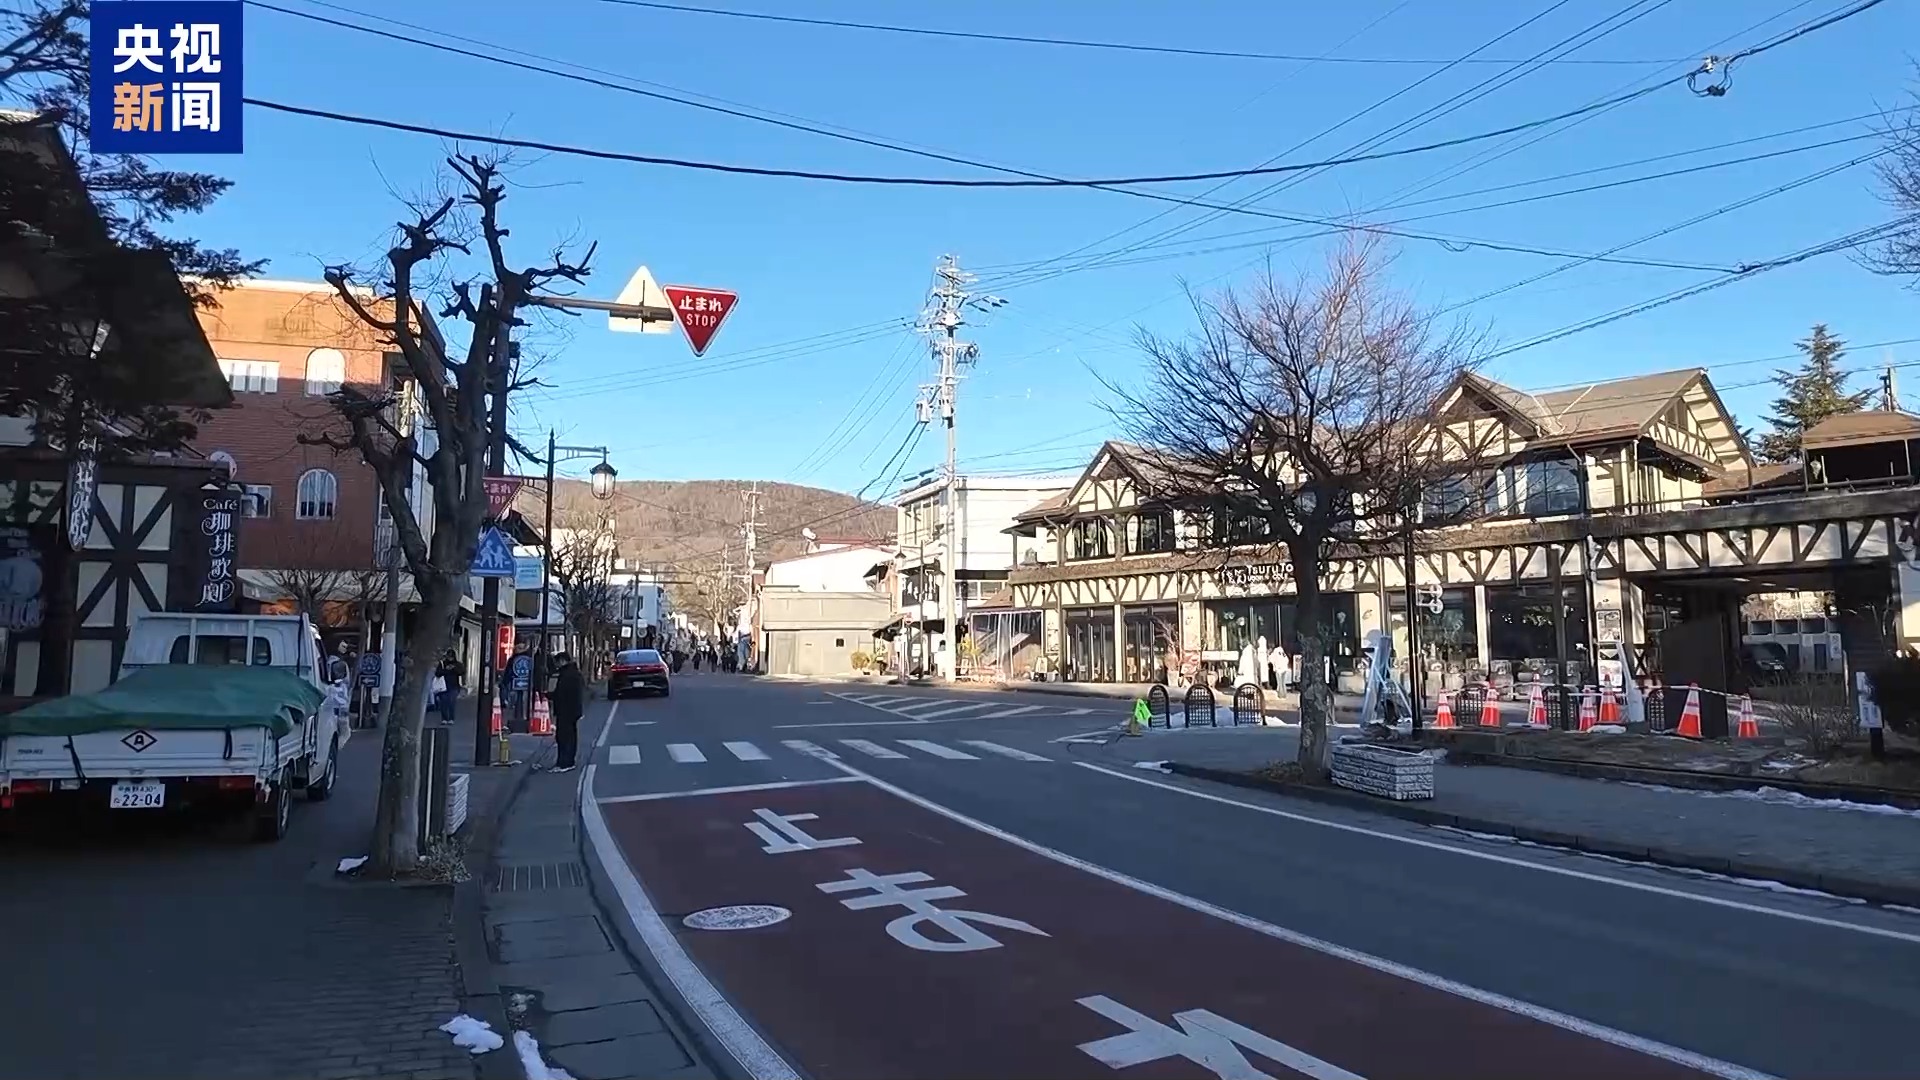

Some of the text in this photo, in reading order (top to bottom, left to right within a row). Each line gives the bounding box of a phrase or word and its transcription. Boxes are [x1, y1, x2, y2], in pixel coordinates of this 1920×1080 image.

[678, 295, 723, 312] 止まれ
[686, 313, 717, 327] STOP
[203, 498, 238, 510] Café
[133, 734, 145, 746] A
[122, 793, 161, 807] 22-04
